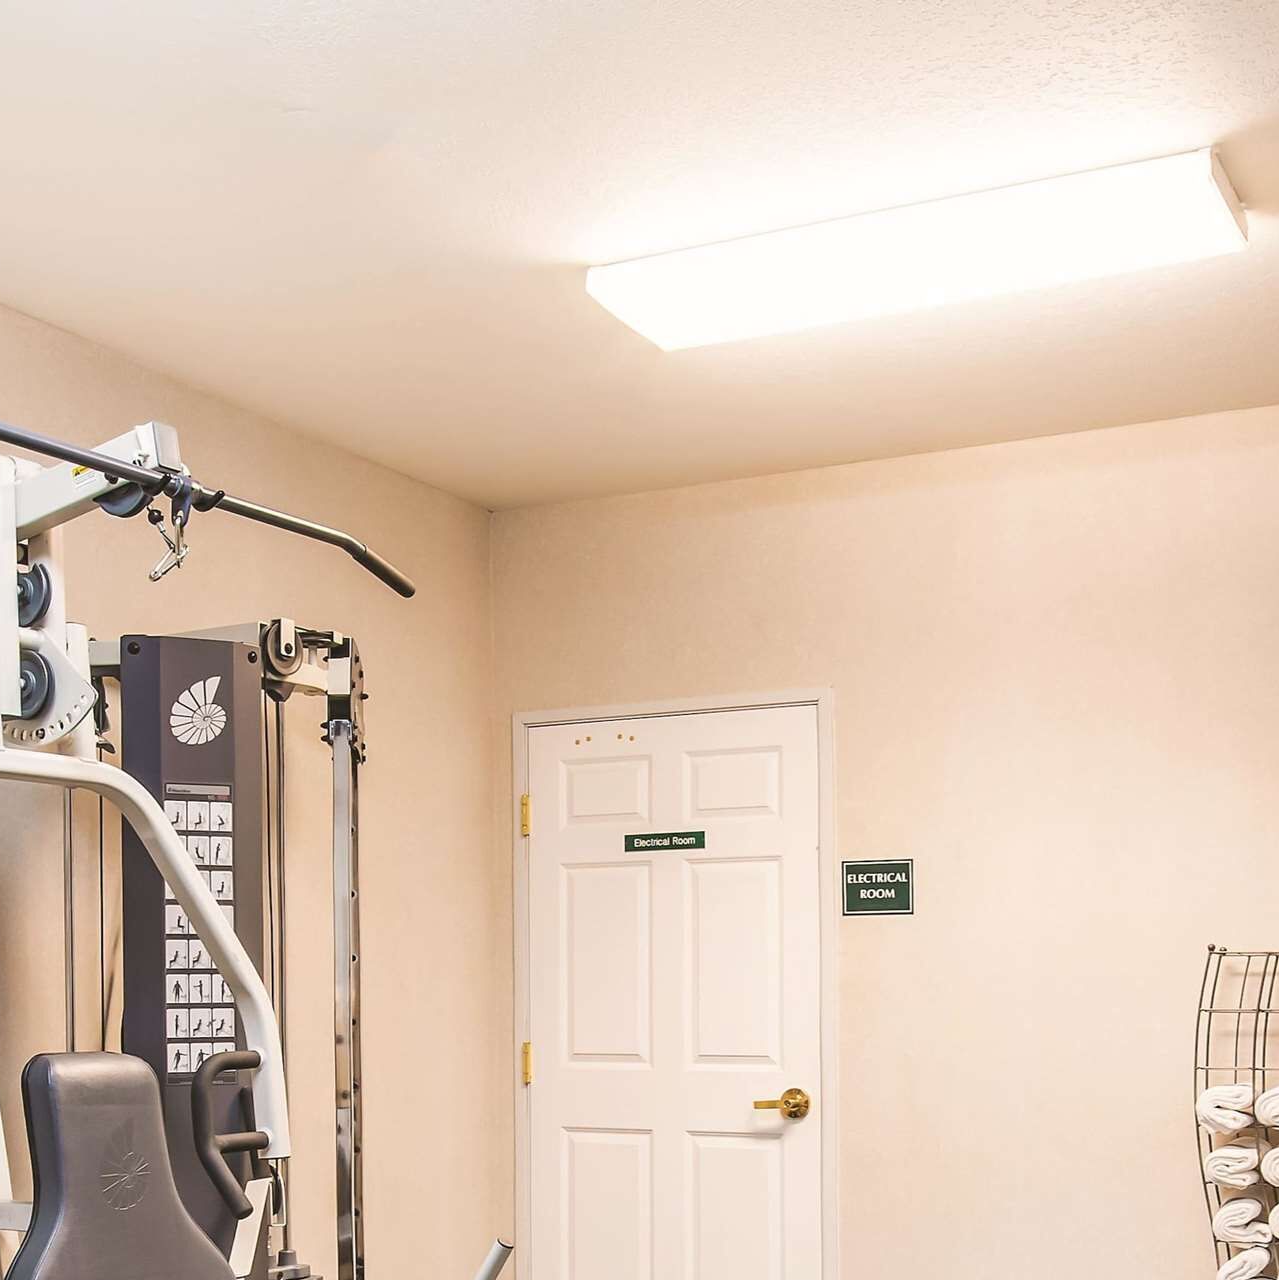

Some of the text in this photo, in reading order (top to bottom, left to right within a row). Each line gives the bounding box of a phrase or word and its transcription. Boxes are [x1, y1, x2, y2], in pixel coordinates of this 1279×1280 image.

[634, 835, 696, 848] Electrical Room
[847, 871, 909, 884] ELECTRICAL
[859, 888, 896, 900] ROOM
